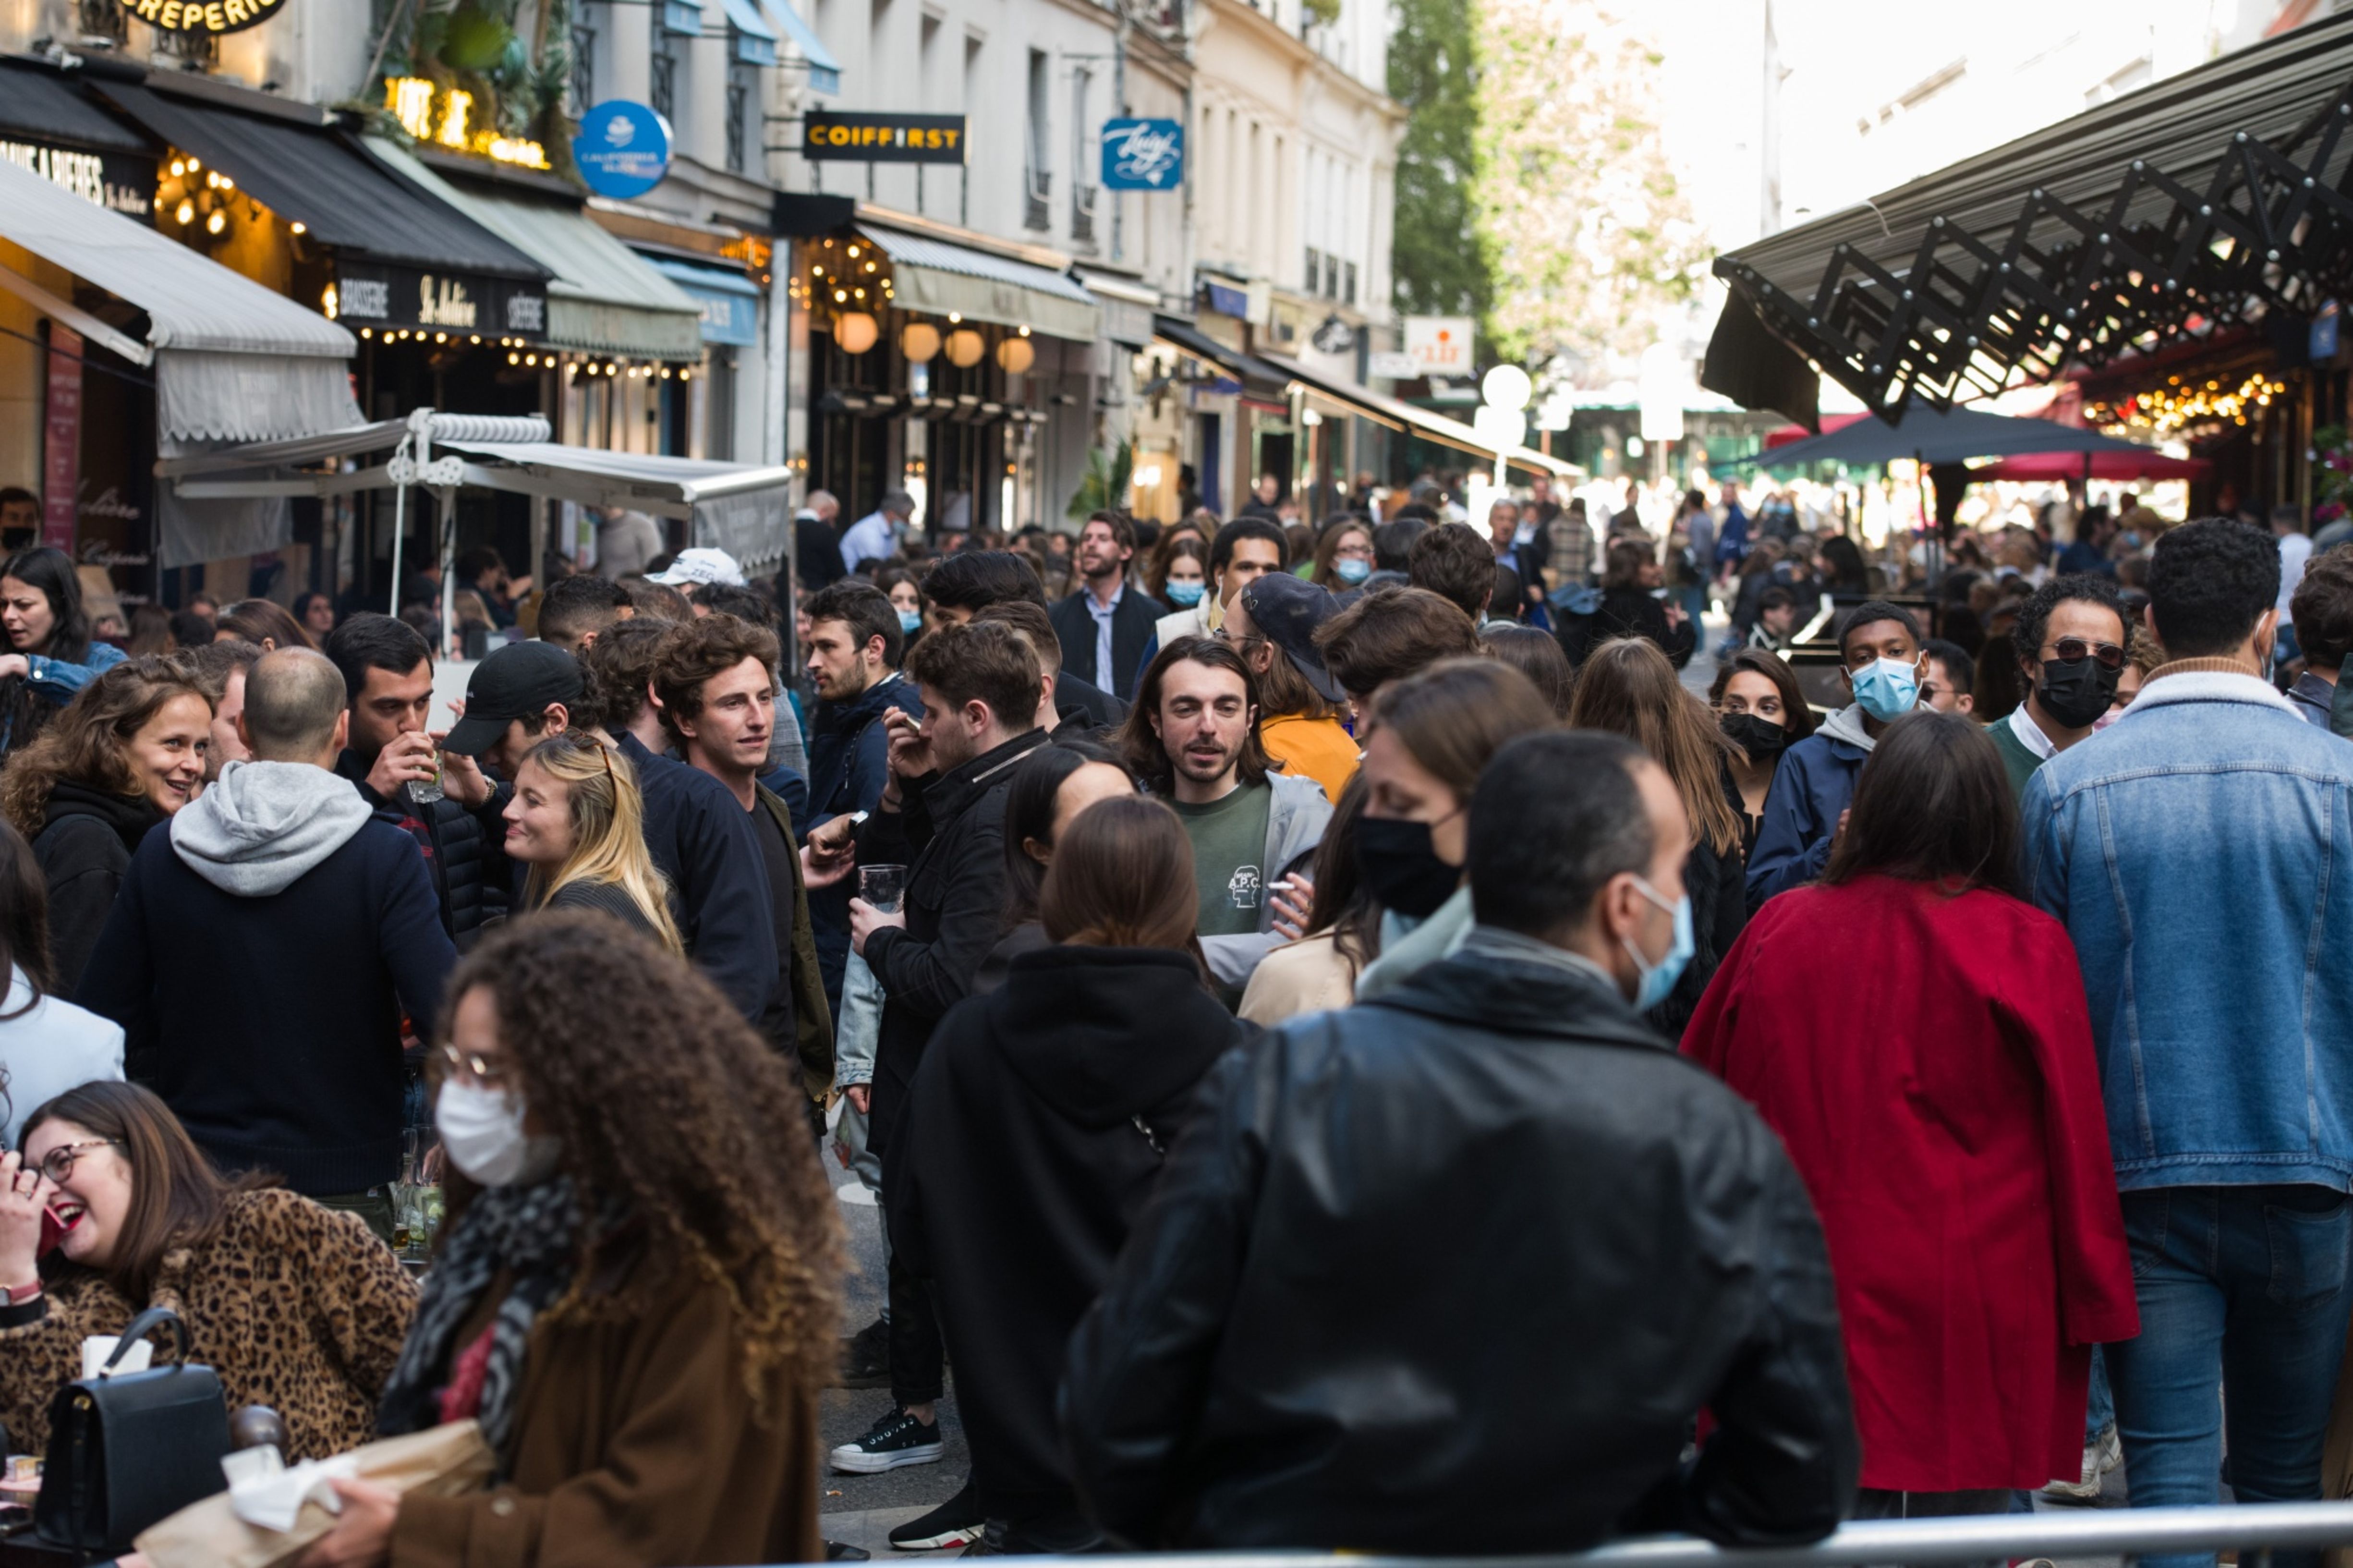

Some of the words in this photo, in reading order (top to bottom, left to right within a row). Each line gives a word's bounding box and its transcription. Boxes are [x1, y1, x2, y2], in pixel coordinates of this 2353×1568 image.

[808, 125, 959, 149] COIFFIRST
[340, 278, 388, 318] BRASSERIE
[1228, 878, 1261, 889] A.P.C.
